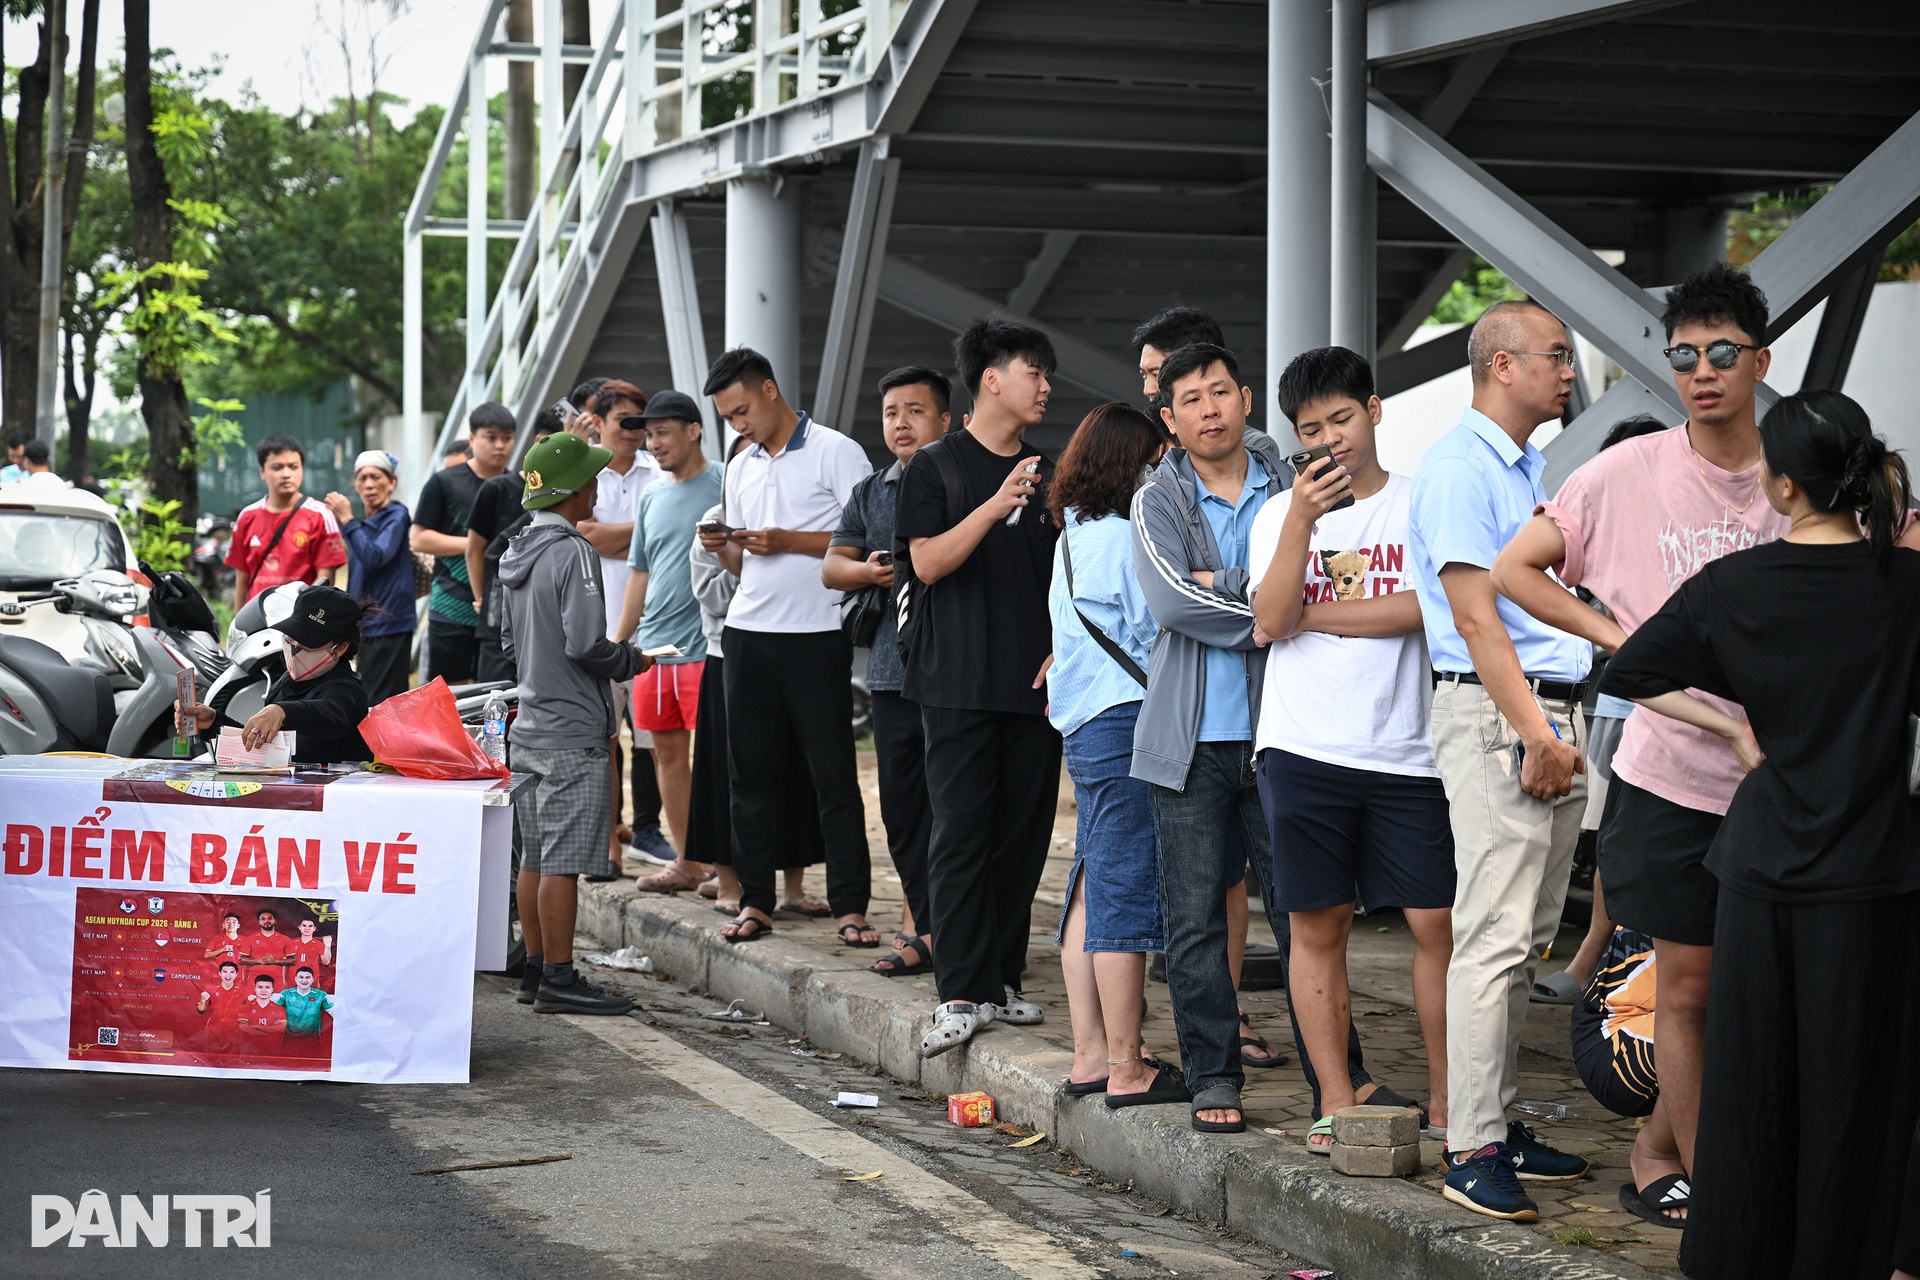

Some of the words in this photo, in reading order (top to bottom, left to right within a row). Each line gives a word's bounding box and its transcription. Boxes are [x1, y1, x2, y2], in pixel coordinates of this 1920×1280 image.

[1373, 577, 1400, 598] IT
[2, 806, 167, 882] ĐIỂM
[189, 825, 321, 890] BÁN
[342, 832, 418, 894] VÉ
[84, 916, 105, 924] ASEAN
[136, 918, 149, 926] CUP
[151, 919, 168, 927] 2026
[192, 921, 198, 929] A
